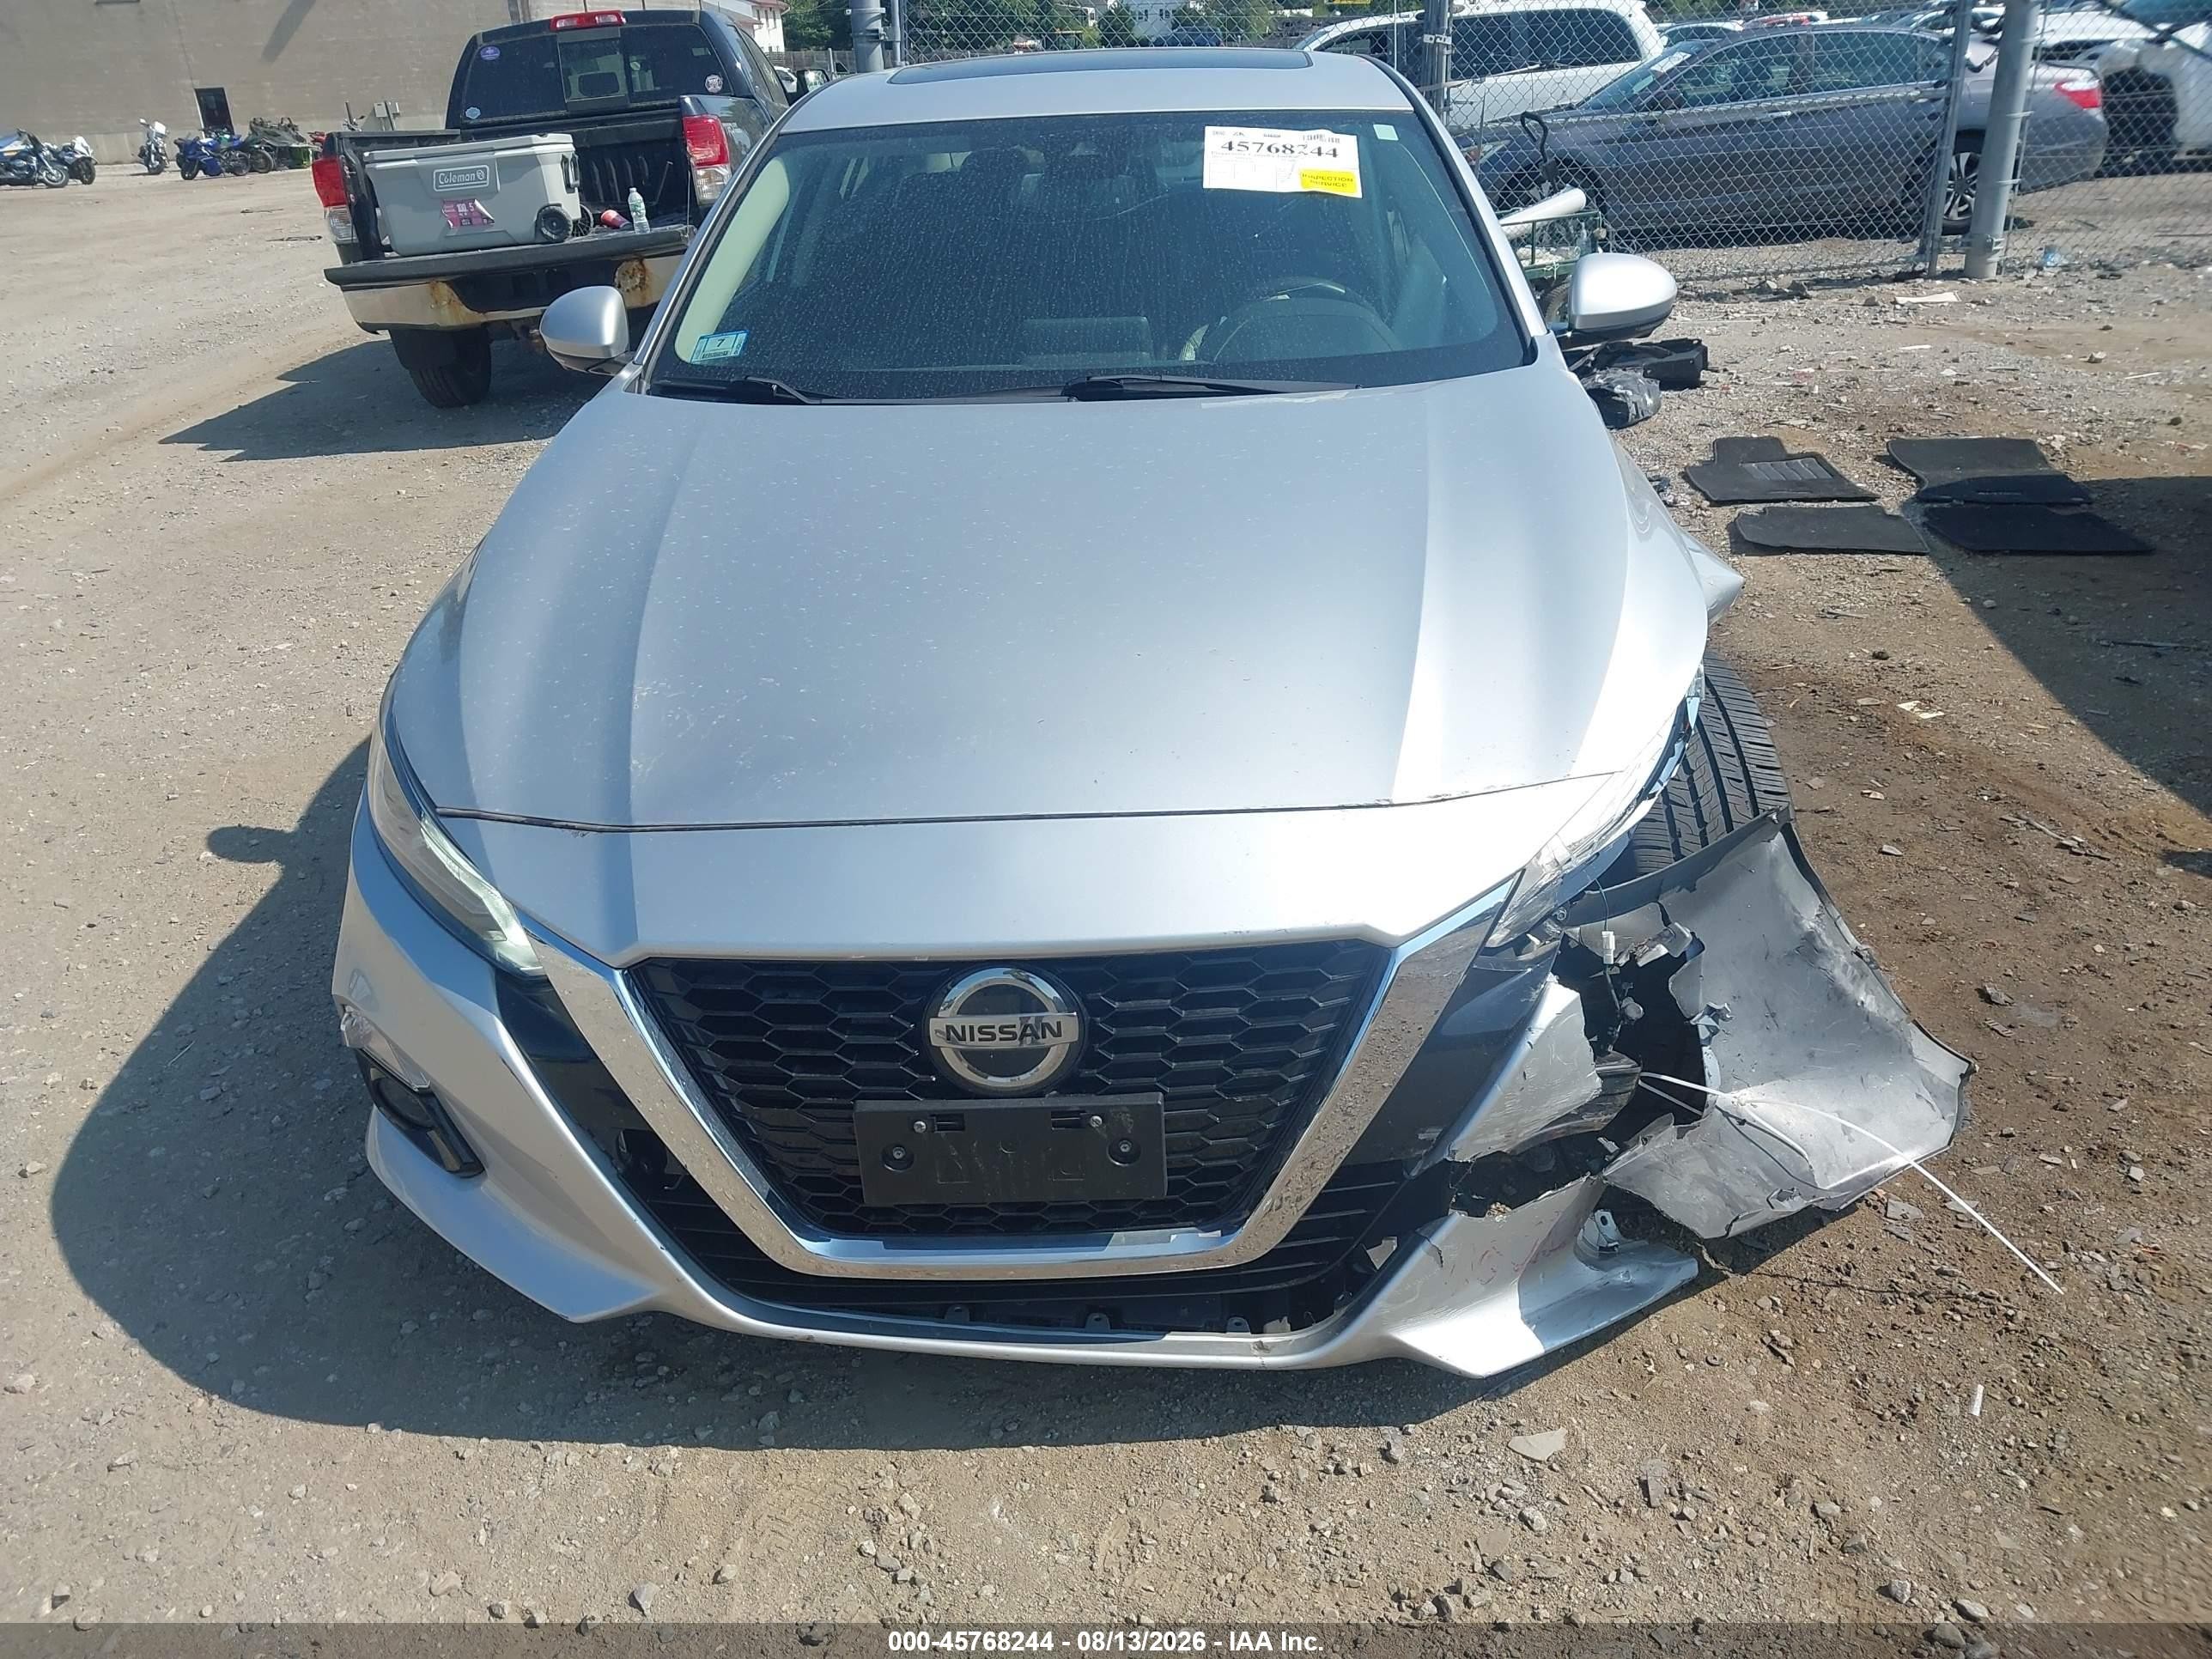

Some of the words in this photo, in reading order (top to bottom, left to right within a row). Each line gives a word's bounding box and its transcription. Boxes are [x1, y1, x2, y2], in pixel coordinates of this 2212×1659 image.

[1221, 141, 1339, 158] 45768244
[439, 172, 476, 184] Coleman
[945, 1021, 1061, 1042] NISSAN
